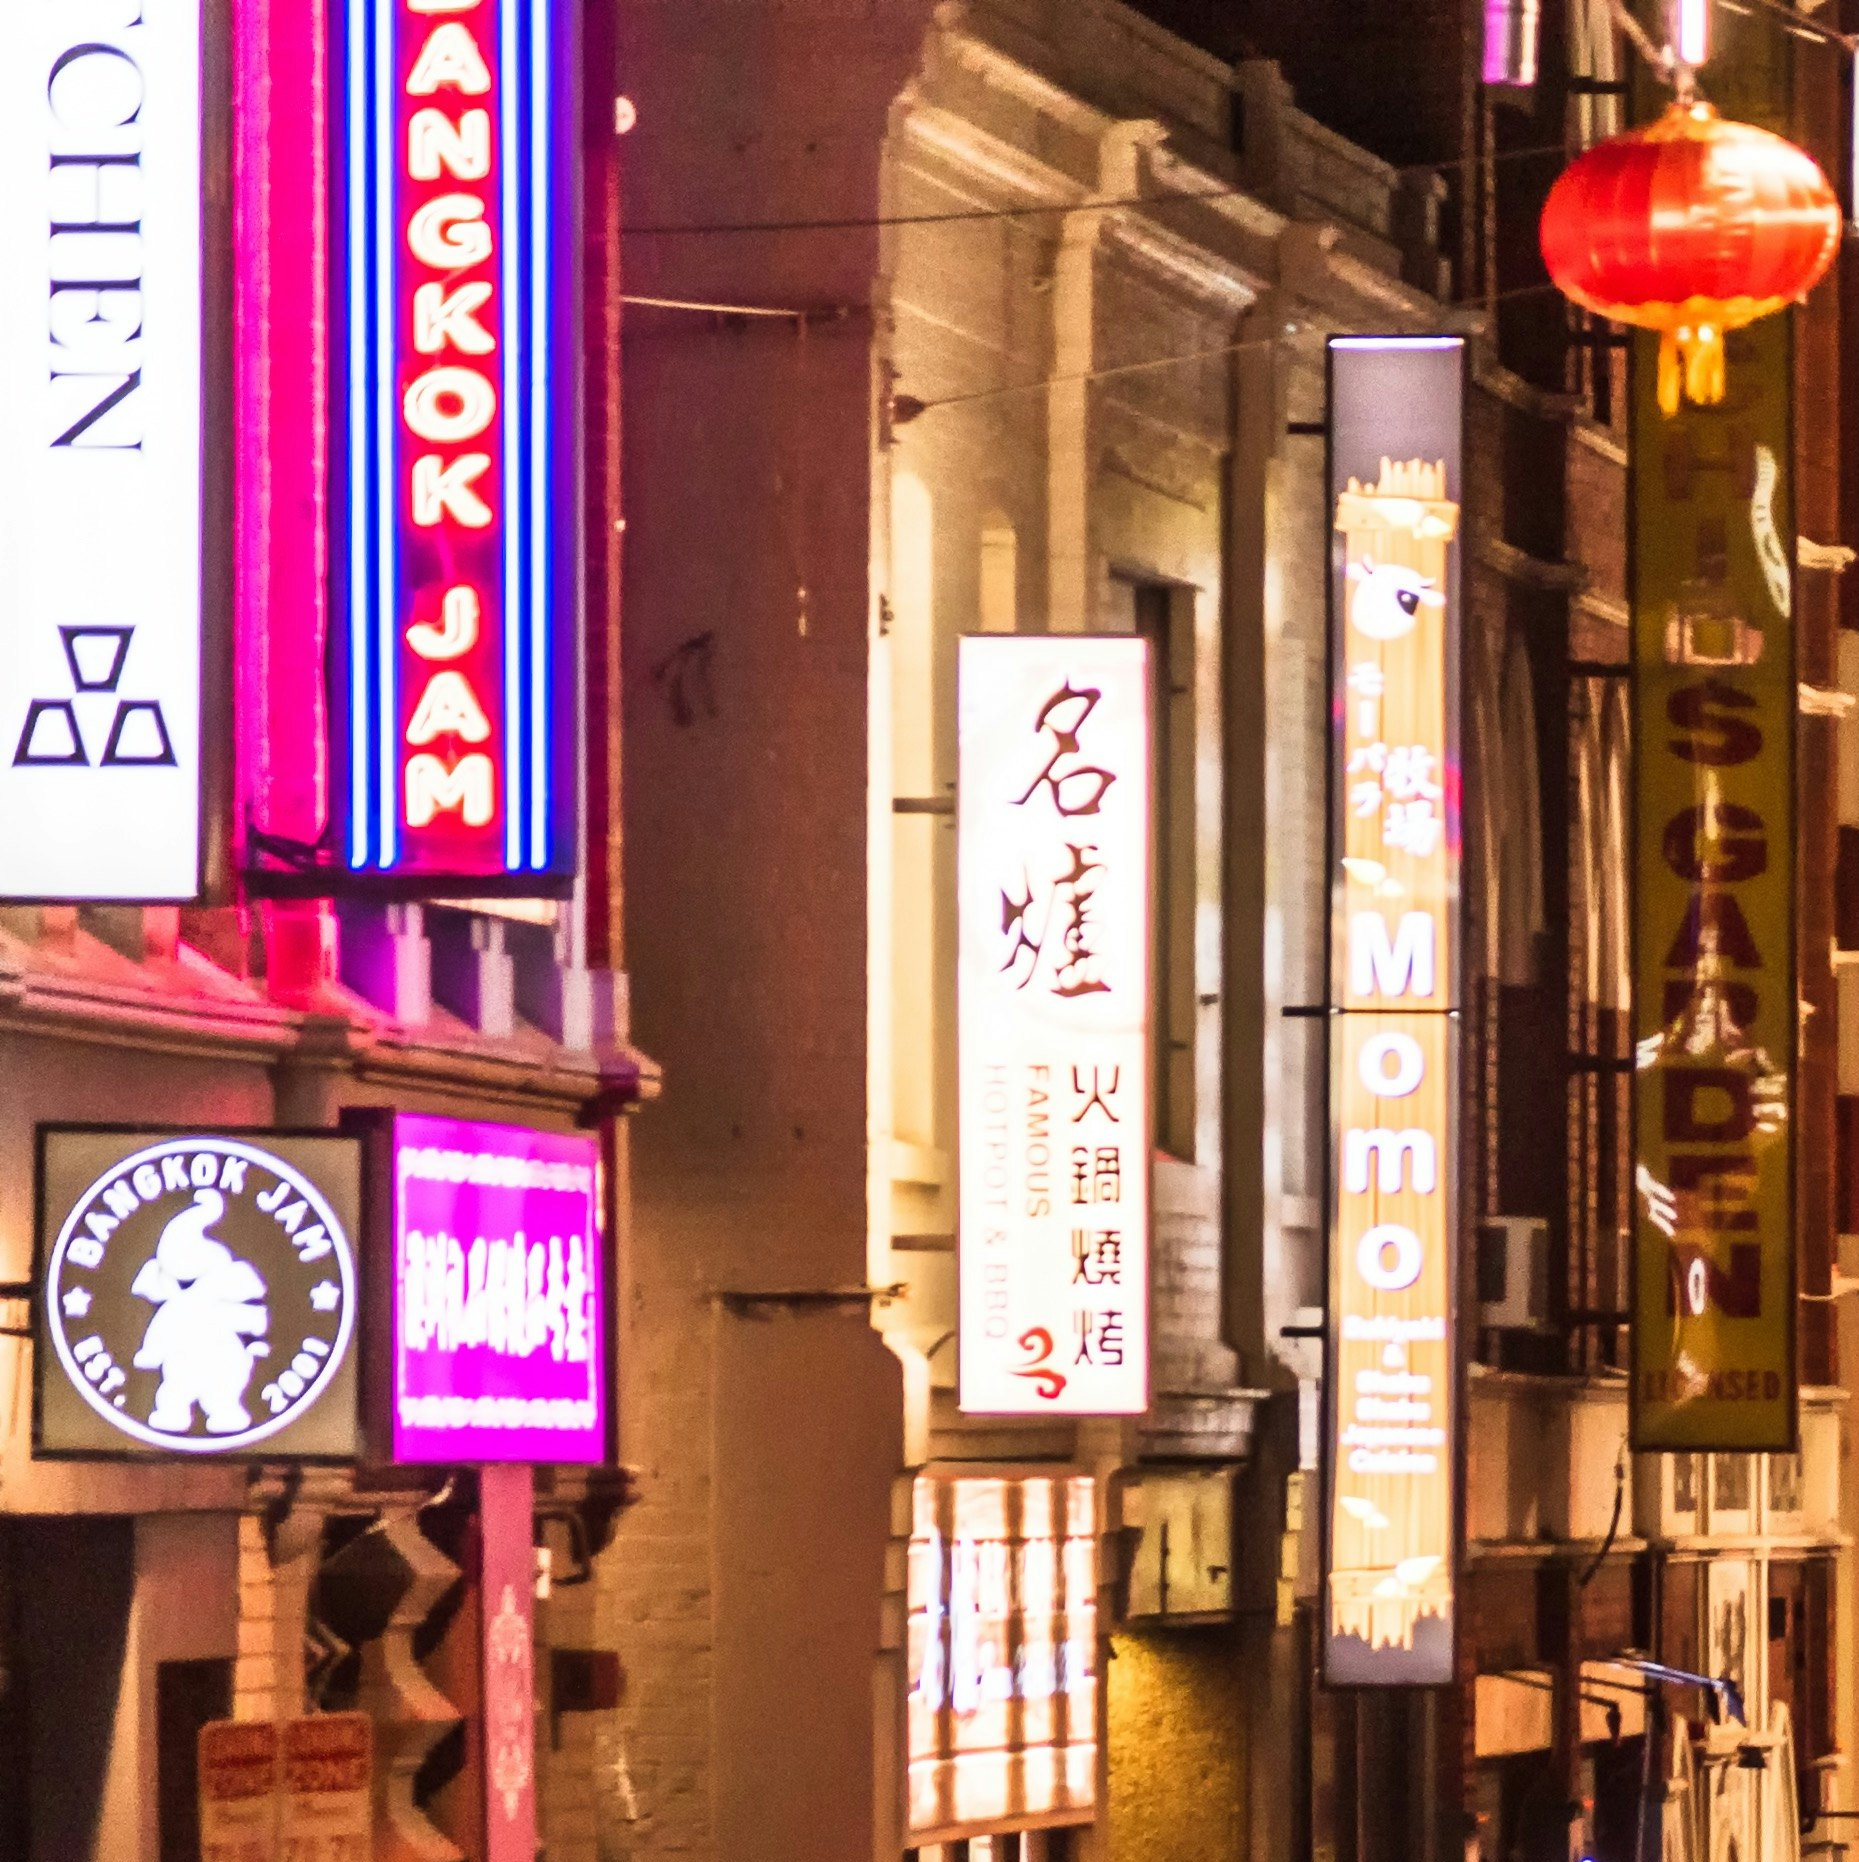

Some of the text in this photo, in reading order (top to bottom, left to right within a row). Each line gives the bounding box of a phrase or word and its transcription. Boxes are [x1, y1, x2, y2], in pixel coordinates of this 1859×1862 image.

[47, 0, 144, 453] CHEN
[404, 0, 496, 828] ANGKOK JAM
[67, 1152, 333, 1271] BANGKOK JAM
[982, 1064, 1009, 1340] HOTPOT & BBQ
[1025, 1064, 1051, 1219] FAMOUS
[1345, 911, 1438, 1291] Momo
[1662, 802, 1768, 1319] GARDEN
[1070, 1062, 1124, 1368] 火鍋燒烤
[72, 1334, 332, 1416] EST. 2001
